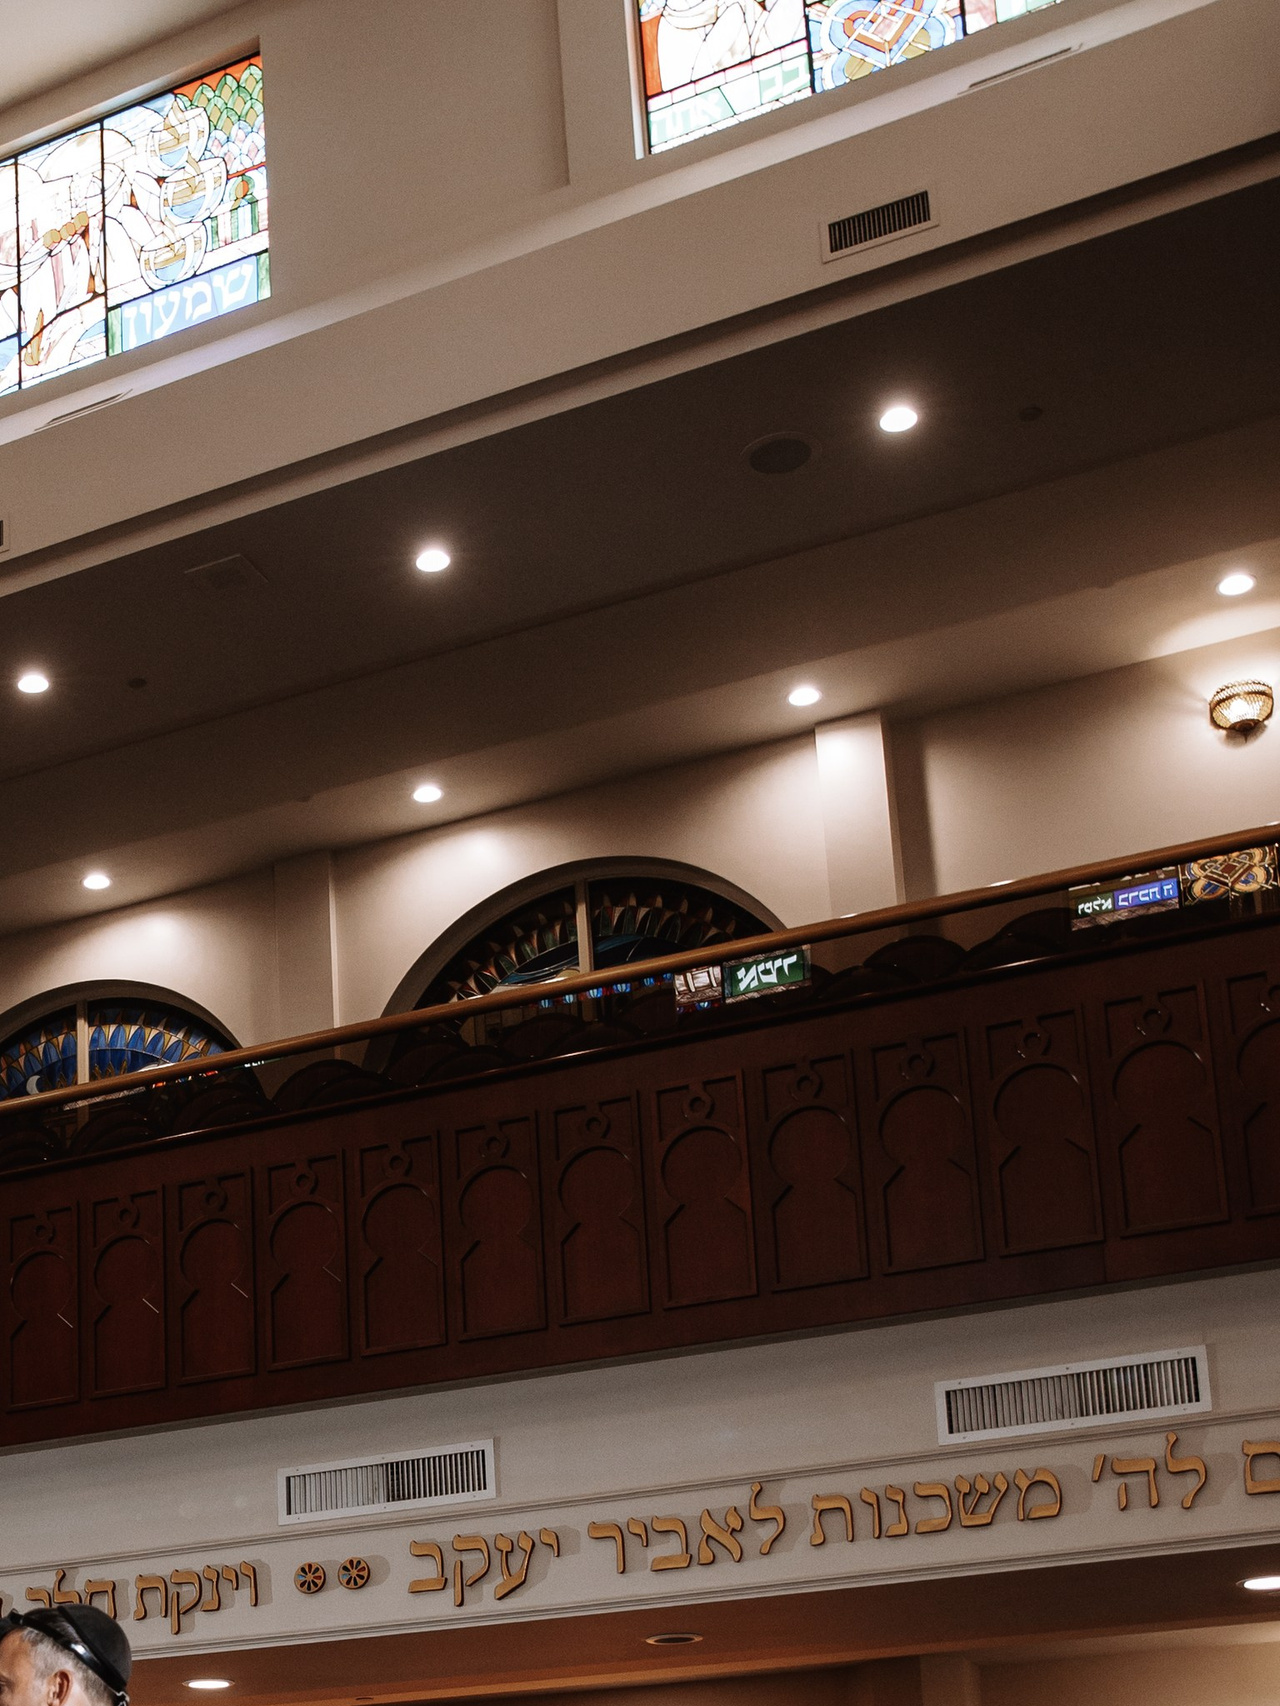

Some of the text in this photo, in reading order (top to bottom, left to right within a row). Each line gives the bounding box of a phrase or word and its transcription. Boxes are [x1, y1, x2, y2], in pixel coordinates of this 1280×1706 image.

[123, 263, 254, 350] שמעון
[588, 1481, 786, 1573] לאביר
[810, 1467, 1062, 1547] משכנות
[133, 1561, 258, 1635] וינקת
[408, 1526, 560, 1607] יעקב
